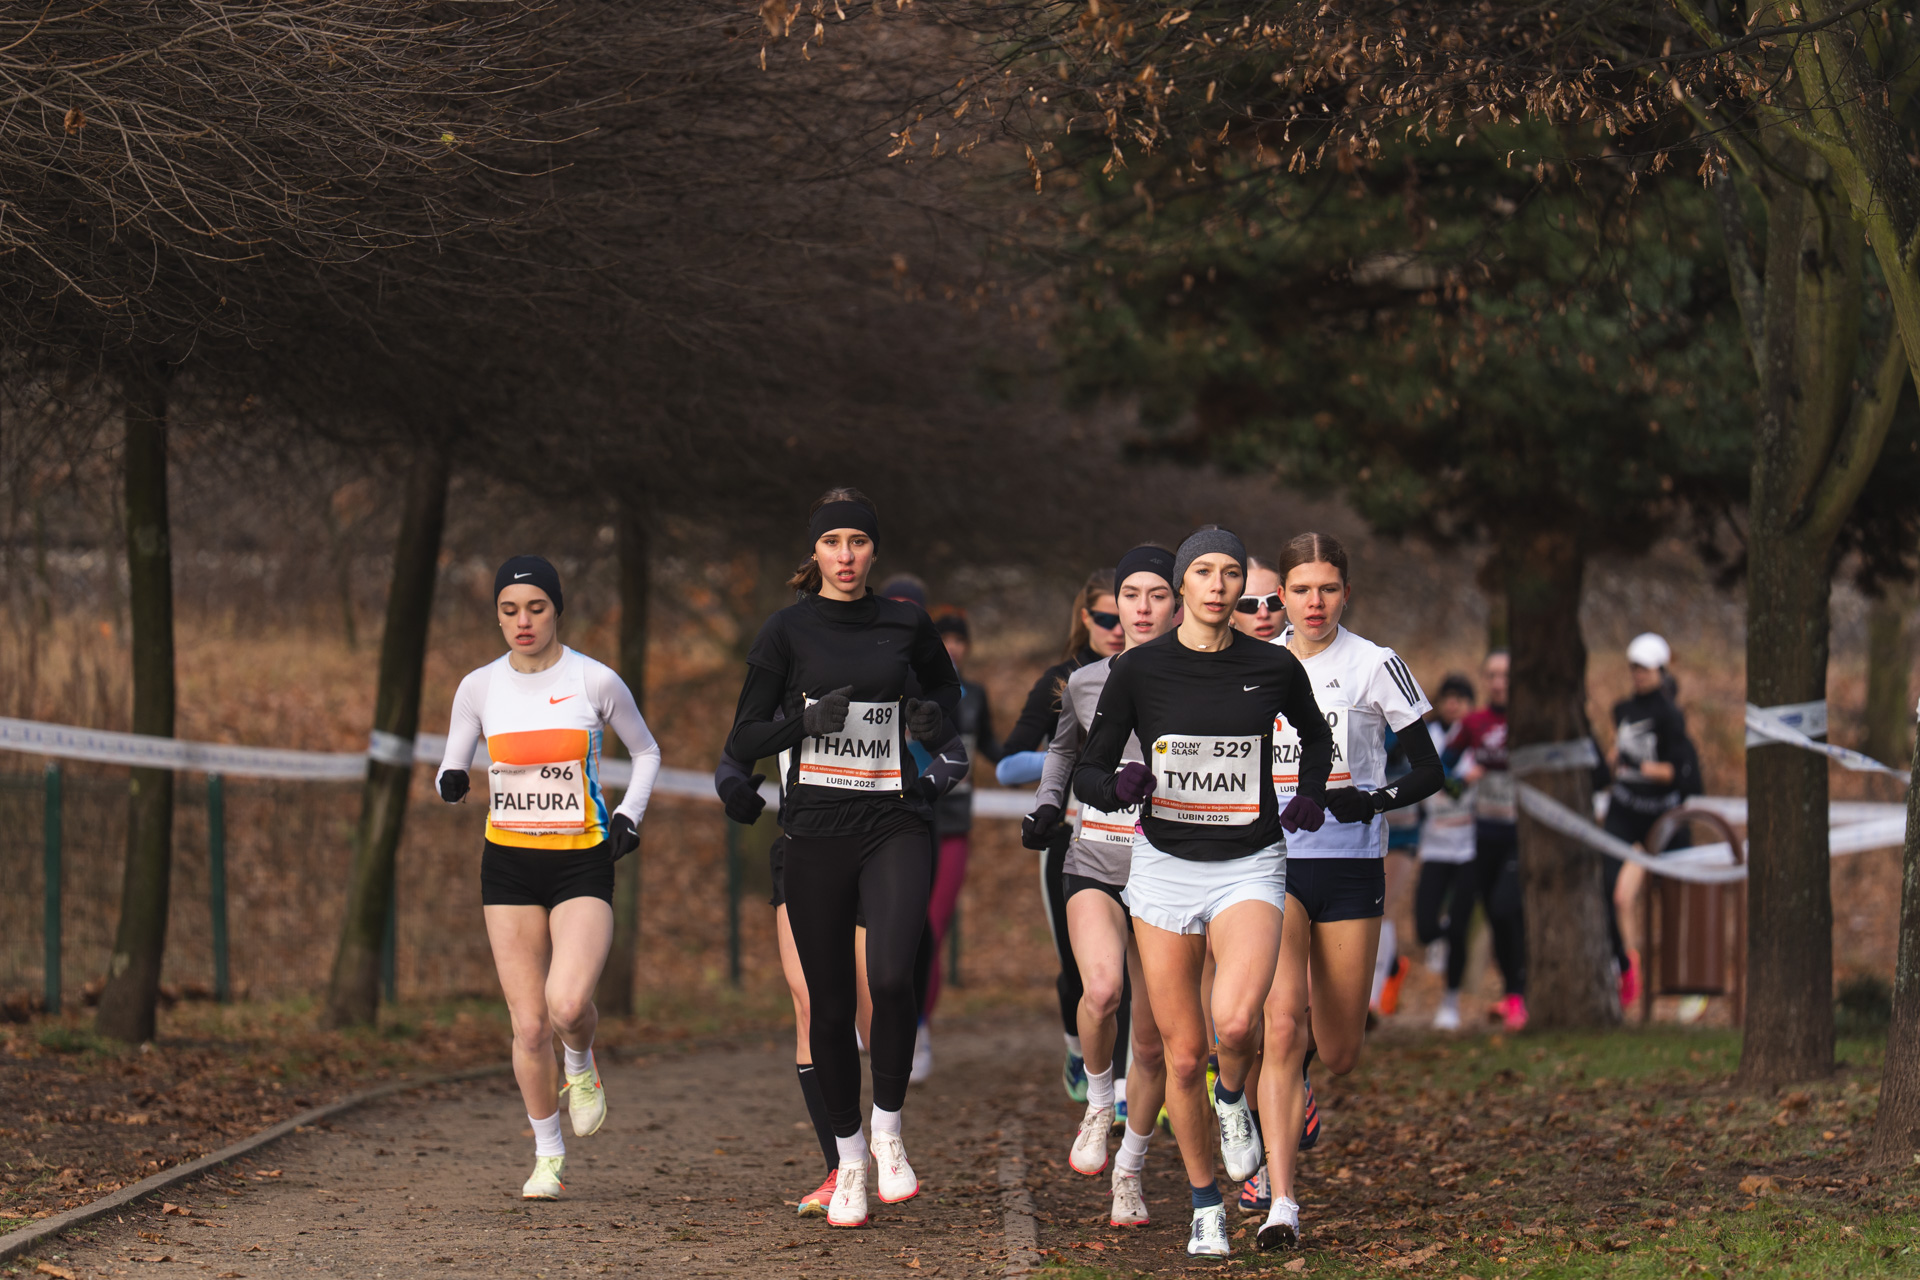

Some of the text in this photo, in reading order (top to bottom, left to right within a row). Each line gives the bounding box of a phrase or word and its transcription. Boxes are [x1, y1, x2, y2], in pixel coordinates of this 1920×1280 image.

[862, 707, 892, 724] 489
[812, 734, 890, 759] THAMM
[1212, 741, 1252, 758] 529
[540, 766, 573, 780] 696
[1164, 770, 1246, 792] TYMAN
[826, 776, 876, 788] LUBIN 2025
[494, 792, 579, 810] FALFURA
[1178, 812, 1204, 821] LUBIN
[1106, 834, 1130, 843] LUBIN
